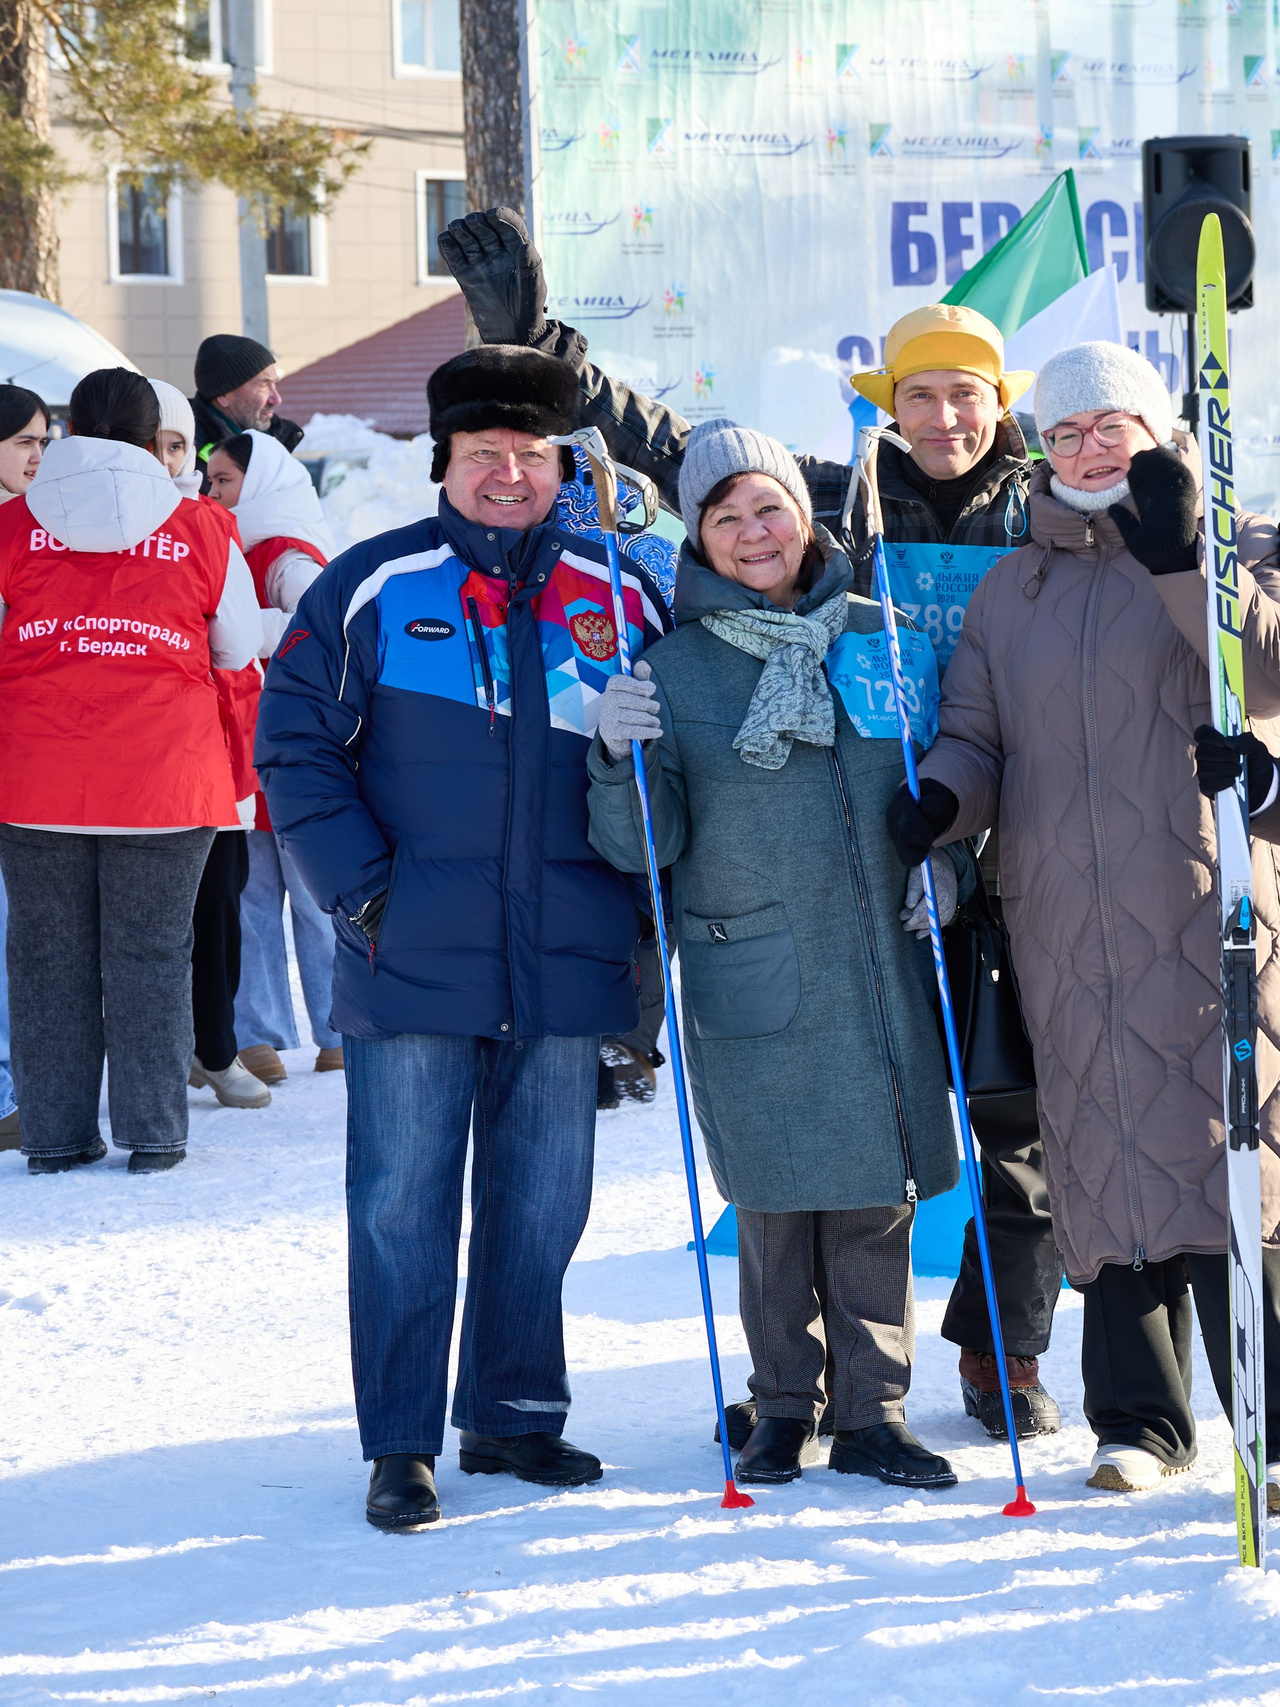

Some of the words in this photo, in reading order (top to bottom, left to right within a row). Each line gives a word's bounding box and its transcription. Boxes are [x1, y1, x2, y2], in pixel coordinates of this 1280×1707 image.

[1208, 397, 1241, 639] FISCHER
[935, 572, 979, 583] ЛЫЖНЯ
[18, 618, 58, 642] МБУ
[62, 615, 190, 650] «Спортоград»
[411, 622, 450, 635] FORWARD
[900, 602, 966, 646] 789
[60, 640, 72, 652] г.
[78, 637, 147, 657] Бердск
